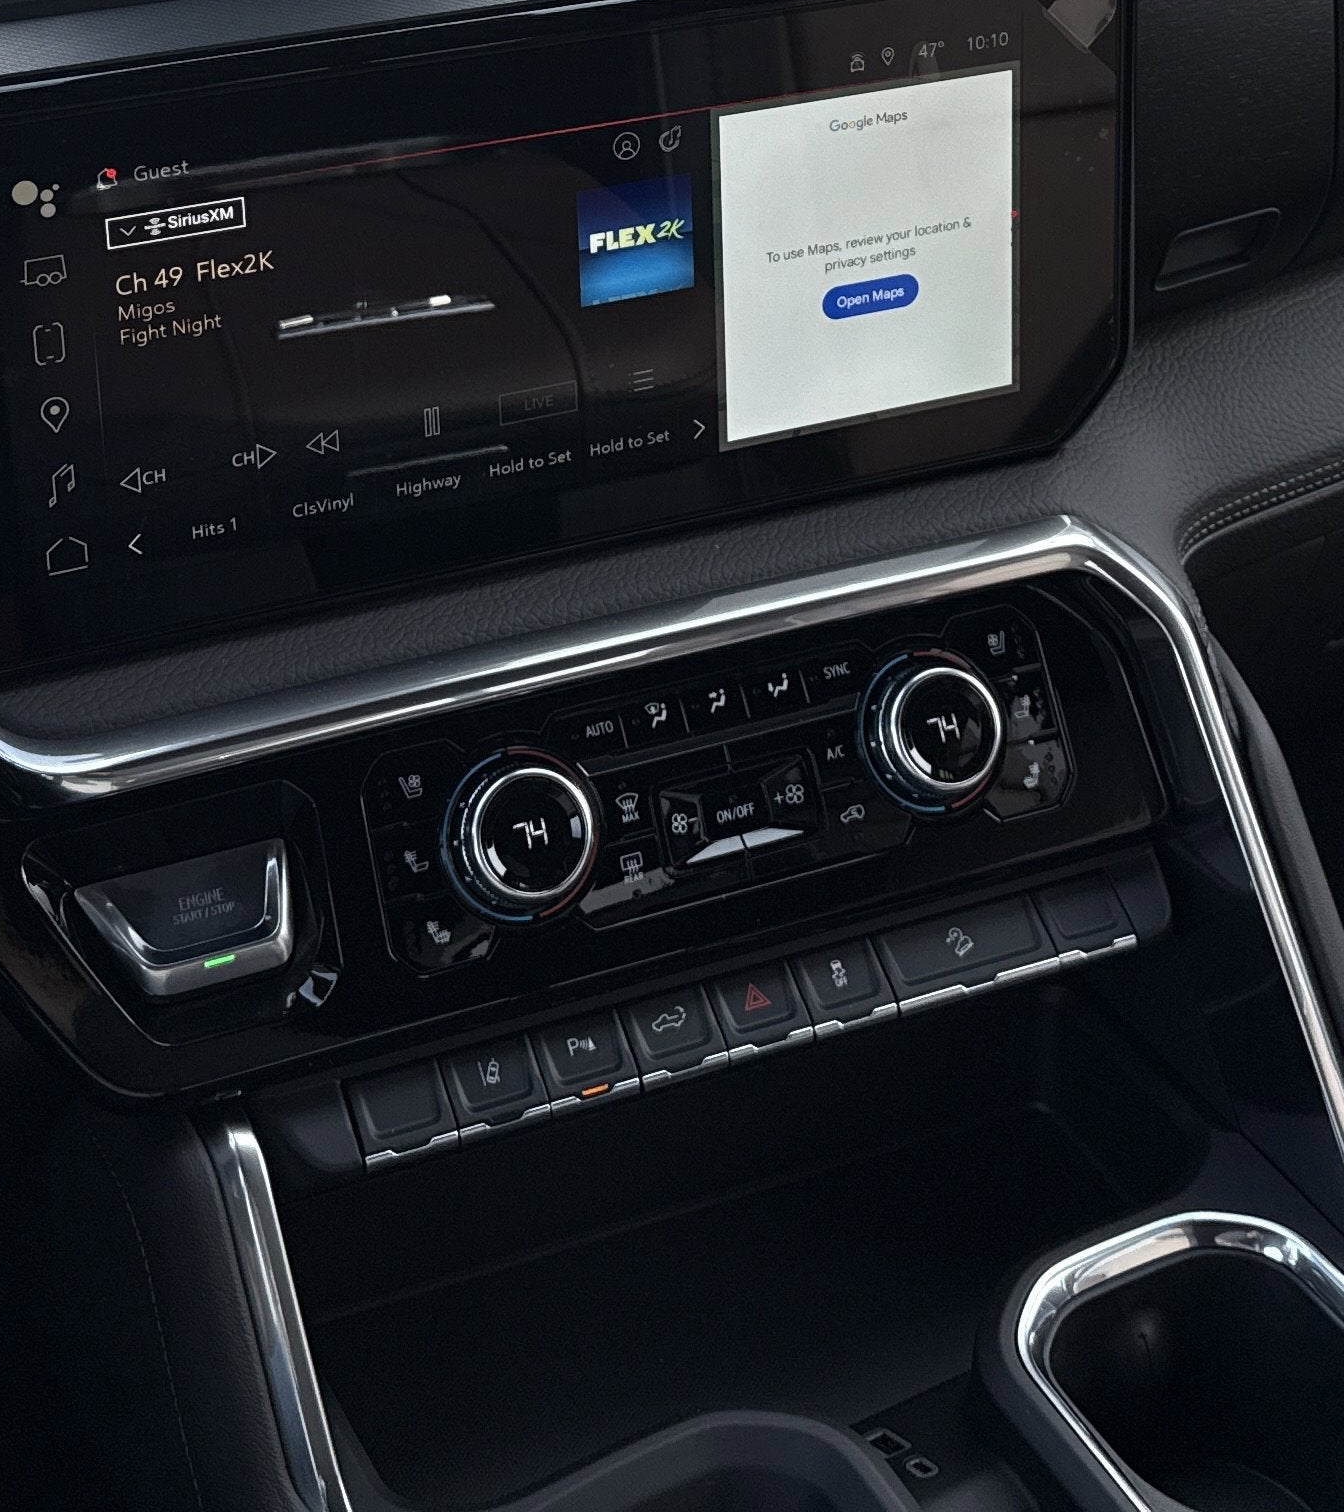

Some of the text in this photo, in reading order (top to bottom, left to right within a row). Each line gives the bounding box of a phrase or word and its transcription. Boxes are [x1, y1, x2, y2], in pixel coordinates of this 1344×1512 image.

[967, 31, 1010, 51] 10:10
[829, 109, 908, 134] Google Maps
[133, 159, 190, 182] Guest
[167, 206, 234, 230] SiriusXM
[589, 218, 685, 255] FLEX 2K
[766, 216, 971, 265] To use Maps, review your location &
[824, 244, 916, 275] privacy settings
[115, 250, 276, 297] Ch 49 Flex2K
[836, 285, 905, 311] Open Maps
[117, 299, 176, 324] Migos
[119, 313, 223, 348] Fight Night
[589, 429, 670, 457] Hold to Set
[231, 450, 256, 468] CH
[489, 449, 572, 477] Hold to Set
[142, 468, 167, 486] CH
[396, 473, 462, 498] Highway
[292, 492, 355, 519] ClsVinyl
[191, 517, 238, 540] Hits 1
[823, 661, 851, 680] SYNC
[585, 720, 614, 739] AUTO
[926, 713, 961, 744] 74
[826, 744, 846, 760] A/C
[716, 802, 755, 824] ON/OFF
[512, 817, 548, 850] 74
[178, 886, 226, 913] ENGINE
